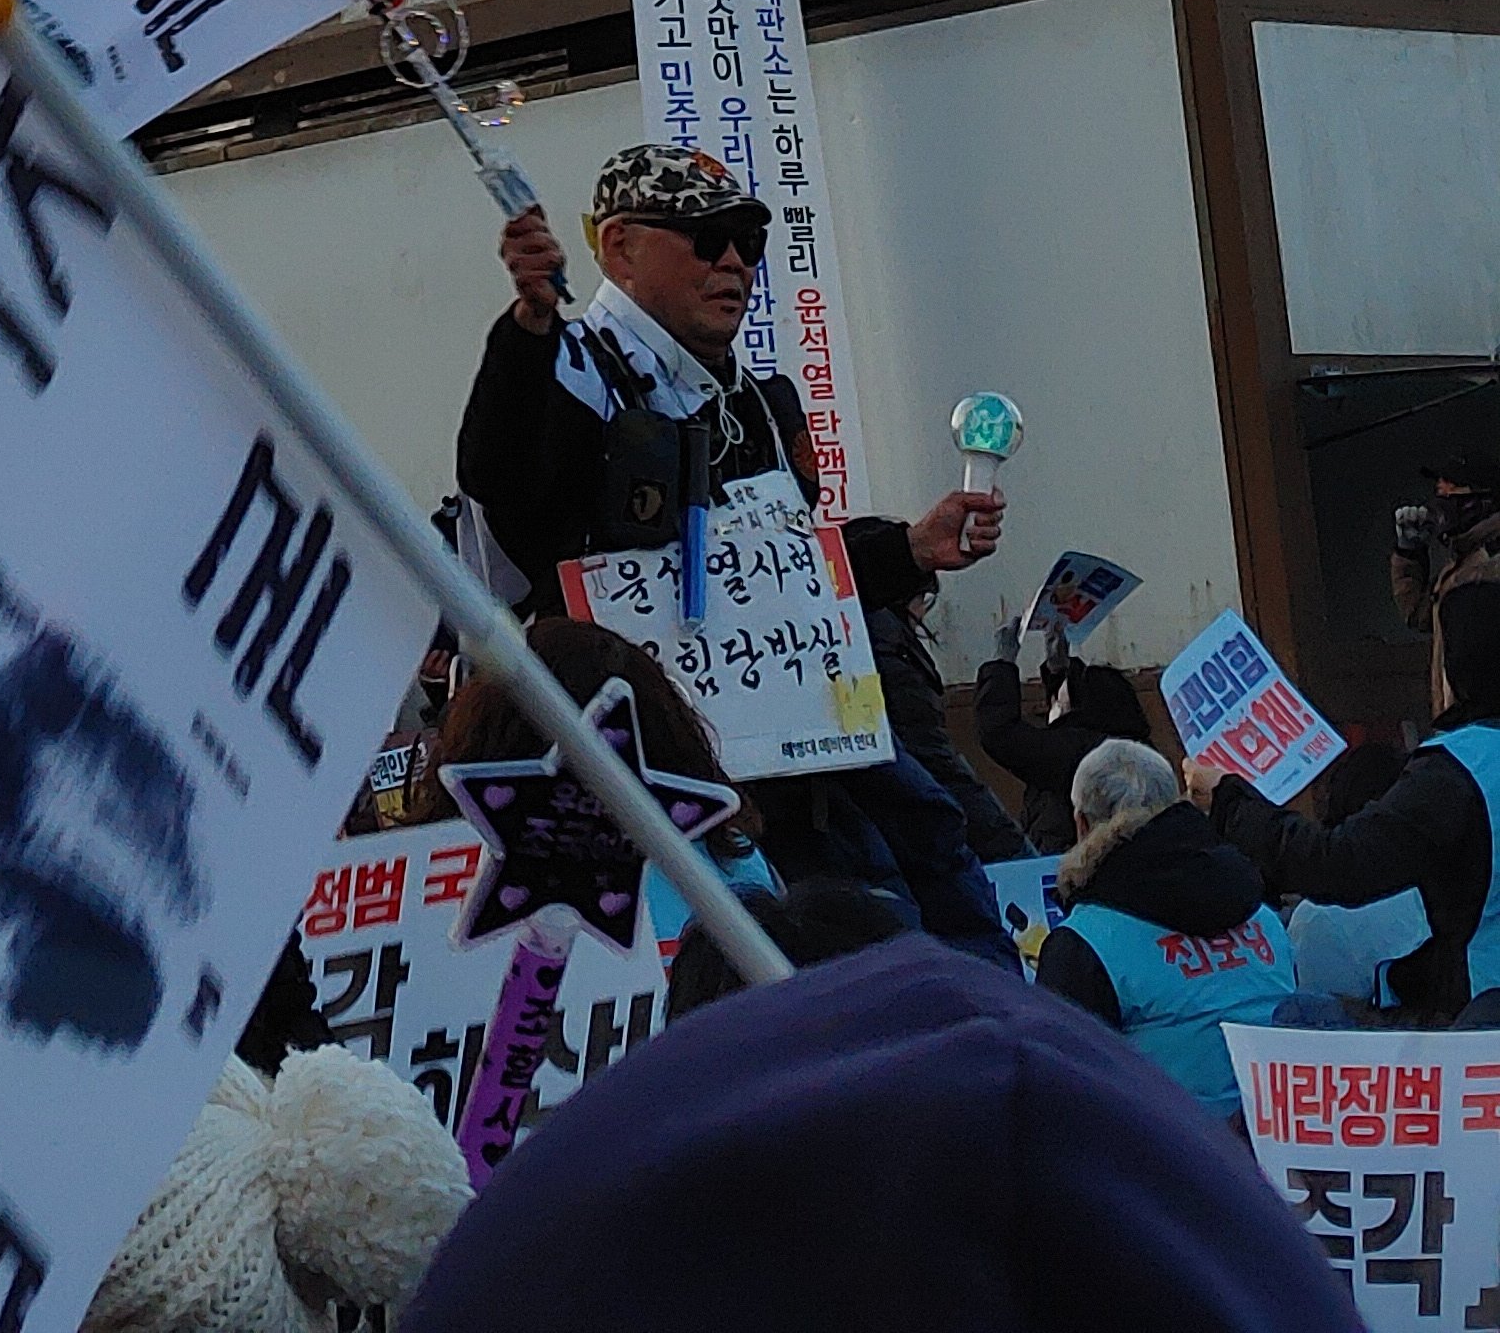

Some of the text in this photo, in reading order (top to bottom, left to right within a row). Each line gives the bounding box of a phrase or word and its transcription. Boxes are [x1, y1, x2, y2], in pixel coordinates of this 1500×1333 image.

[771, 125, 810, 197] 하루
[782, 206, 818, 279] 빨리
[793, 287, 836, 401] 윤석열
[1250, 1061, 1443, 1147] 내란정범
